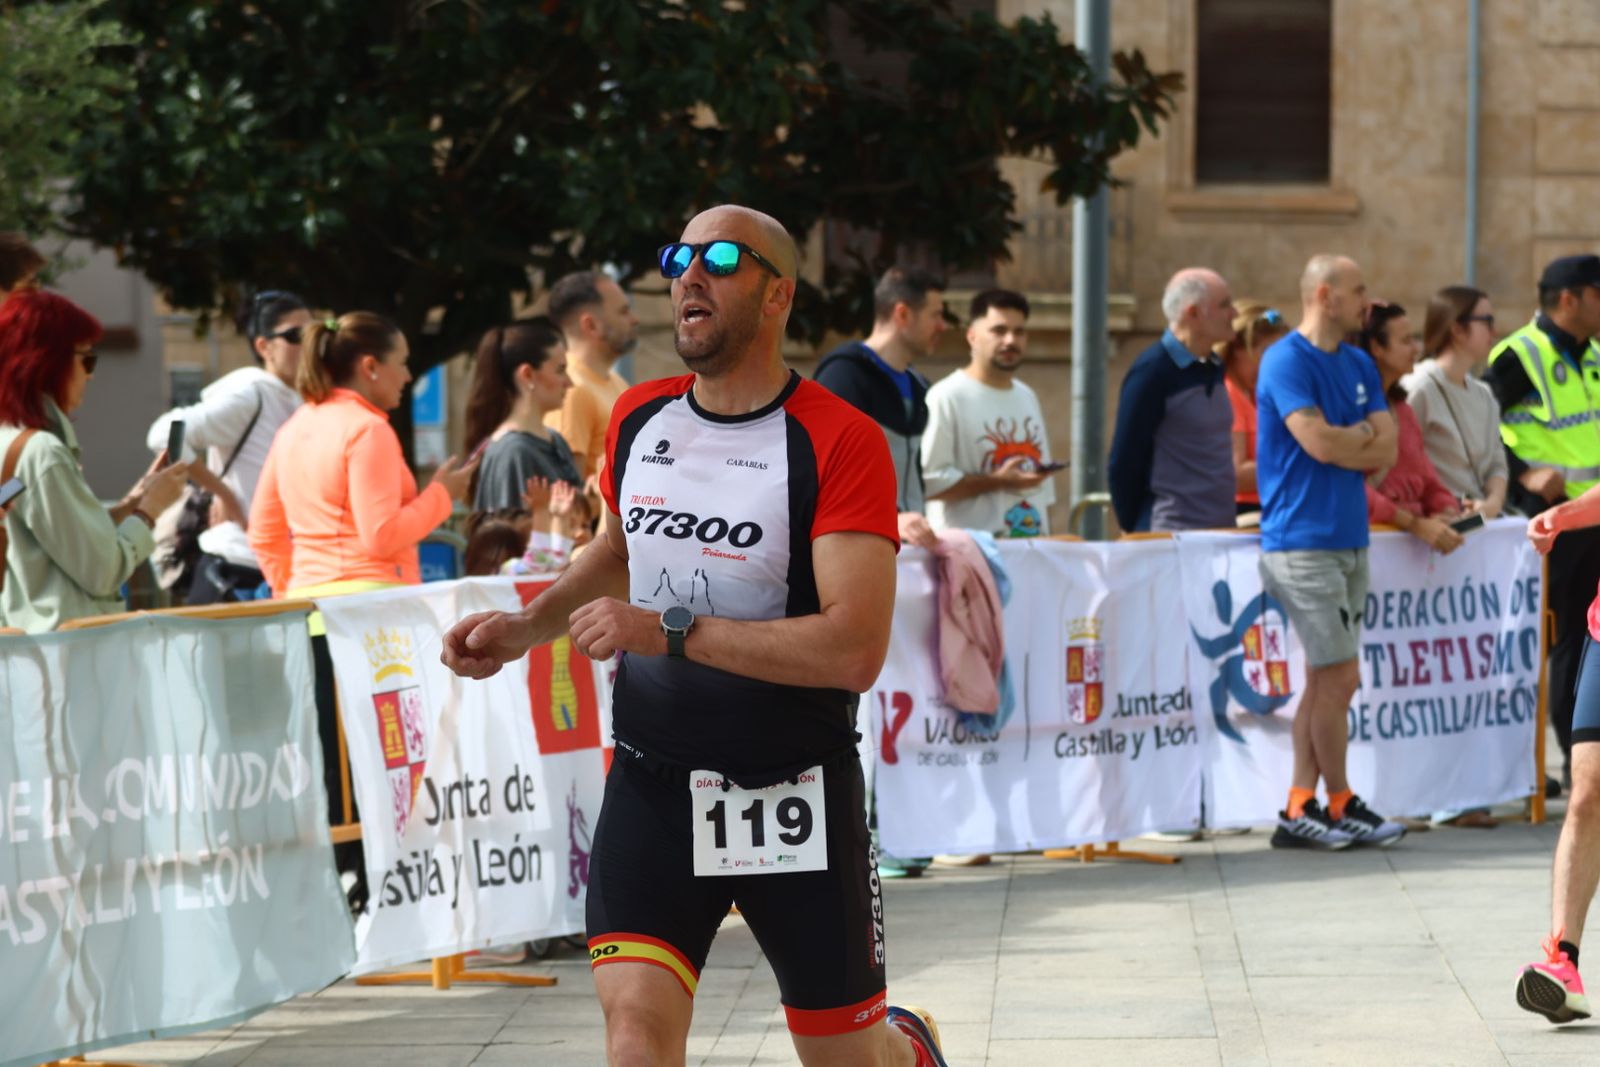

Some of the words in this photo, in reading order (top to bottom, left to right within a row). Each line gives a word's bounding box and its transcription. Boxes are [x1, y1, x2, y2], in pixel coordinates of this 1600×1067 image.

[641, 454, 675, 466] VIATOR
[726, 458, 768, 470] CARABIAS
[625, 507, 763, 548] 37300
[701, 547, 748, 561] Peñaranda
[1363, 576, 1500, 630] DERACIÓN
[1359, 626, 1538, 689] TLETISMO
[1131, 731, 1145, 760] y
[0, 781, 31, 843] E
[504, 763, 536, 814] de
[706, 796, 813, 849] 119
[451, 854, 463, 910] y
[473, 833, 542, 888] León
